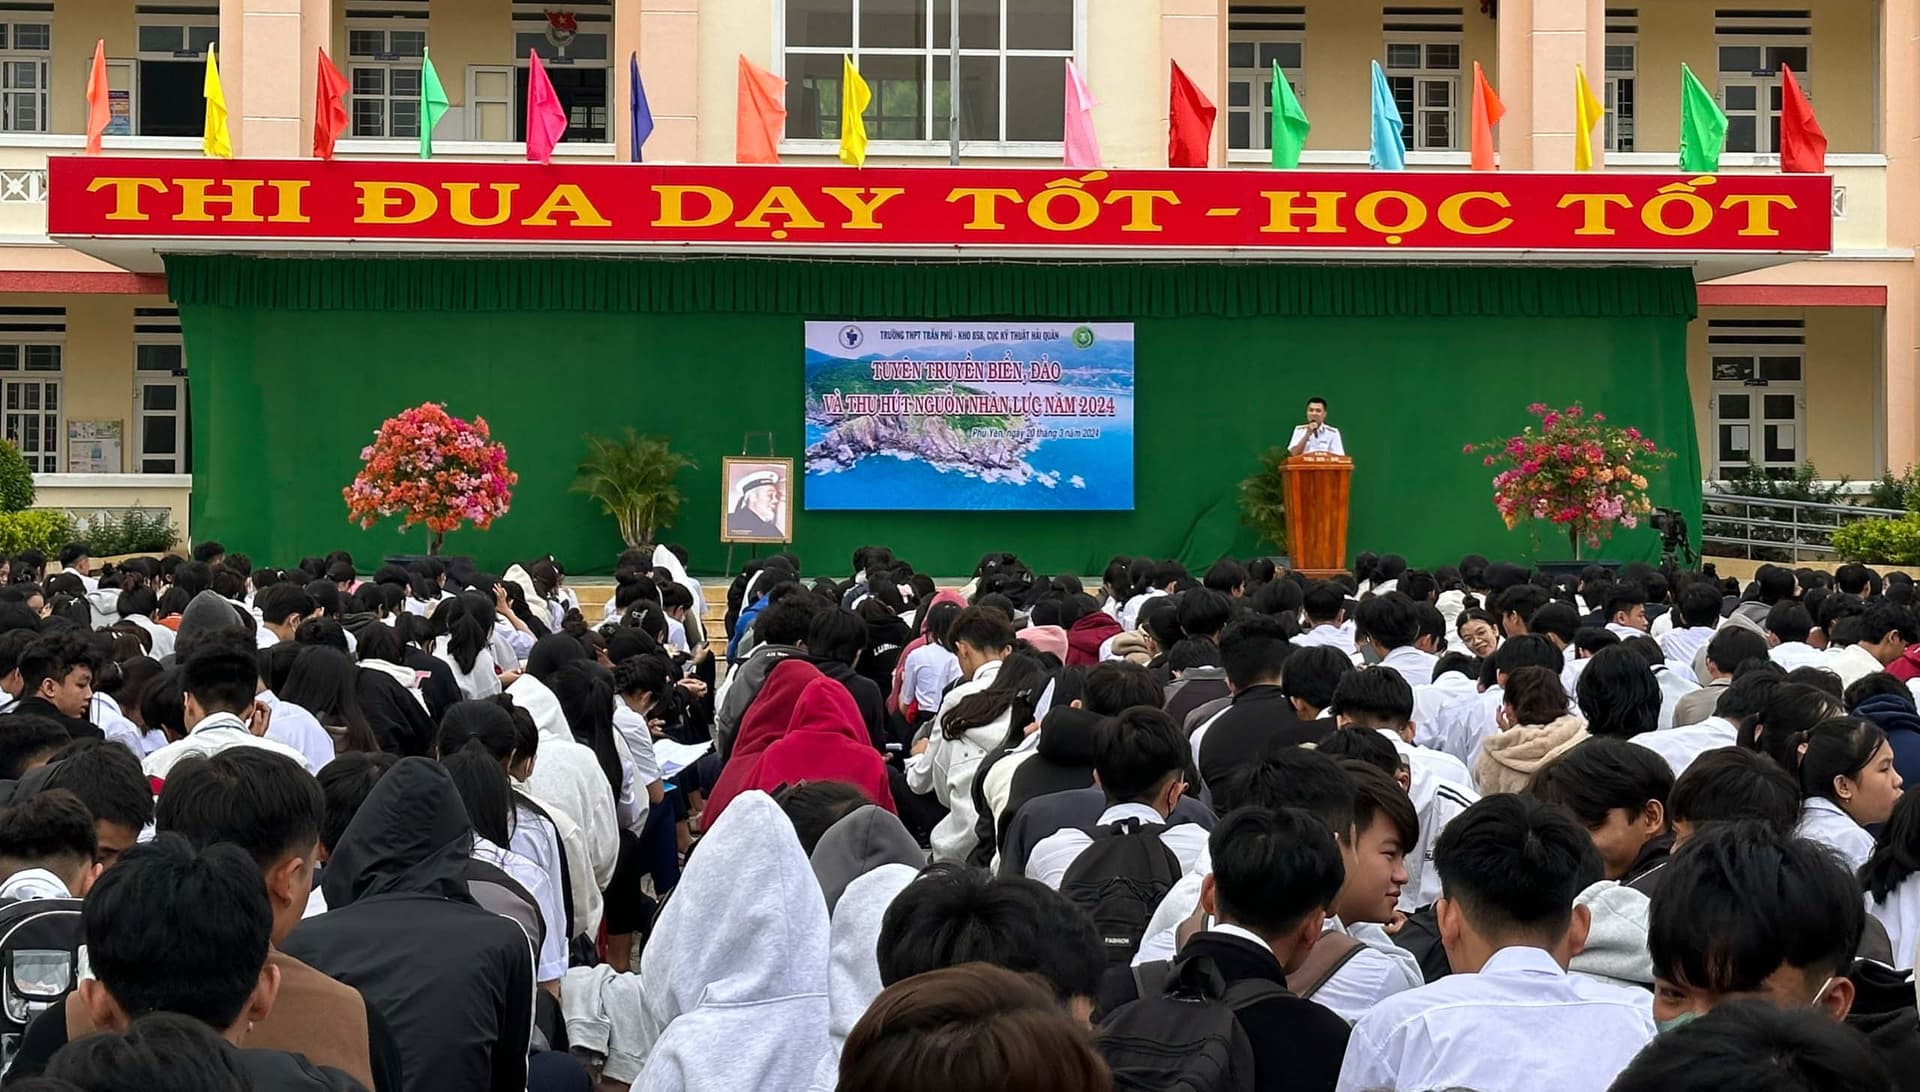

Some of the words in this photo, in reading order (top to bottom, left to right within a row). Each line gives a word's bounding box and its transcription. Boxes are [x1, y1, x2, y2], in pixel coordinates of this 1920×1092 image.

[87, 177, 311, 222] THI
[355, 182, 611, 226] ĐUA
[651, 186, 904, 239] DẠY
[946, 171, 1180, 232] TỐT
[1207, 208, 1239, 216] -
[1261, 190, 1514, 245] HỌC
[1557, 176, 1797, 236] TỐT
[906, 331, 921, 340] THPT
[958, 331, 971, 340] KHO
[872, 356, 921, 380] TUYÊN
[925, 352, 984, 381] TRUYỀN
[987, 351, 1027, 385] BIỂN,
[1030, 354, 1061, 381] ĐẢO
[823, 389, 843, 415] VÀ
[846, 395, 878, 415] THU
[880, 389, 911, 416] HÚT
[914, 386, 966, 416] NGUỒN
[968, 391, 1009, 416] NHÂN
[1012, 391, 1041, 420] LỰC
[1044, 392, 1076, 416] NĂM
[1079, 396, 1115, 416] 2024
[1026, 428, 1036, 439] 20
[1059, 429, 1064, 438] 3
[1083, 428, 1099, 439] 2024
